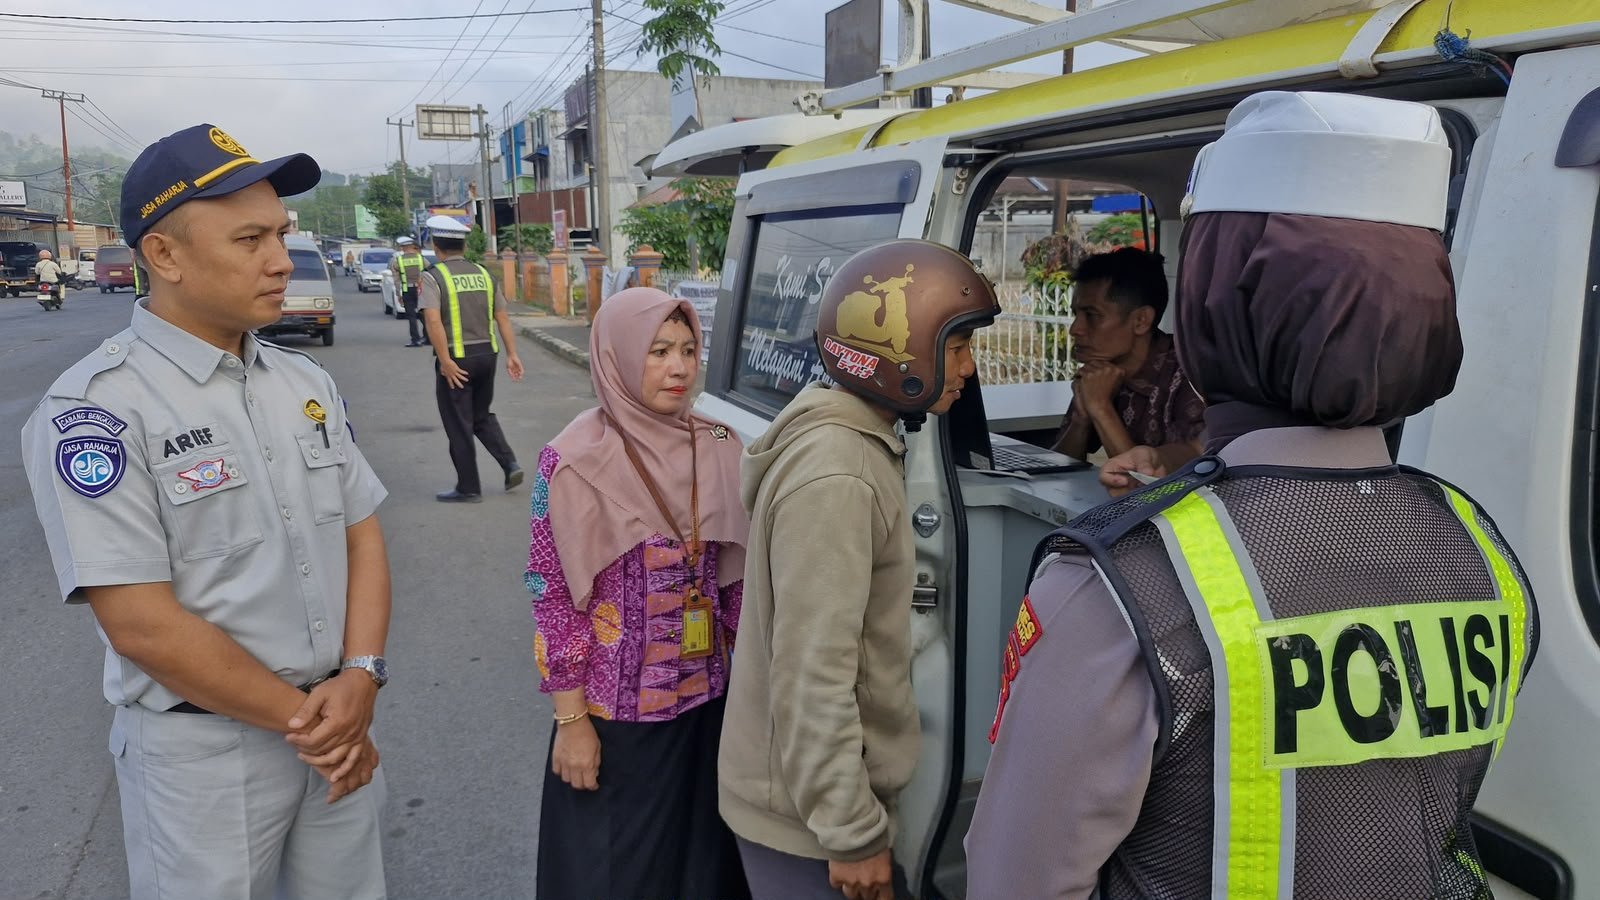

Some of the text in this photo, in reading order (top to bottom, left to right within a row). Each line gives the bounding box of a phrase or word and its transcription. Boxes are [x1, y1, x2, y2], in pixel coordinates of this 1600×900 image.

[140, 180, 188, 219] JASA RAHARJA
[772, 254, 811, 300] Kami
[748, 327, 807, 390] Melayani
[824, 337, 879, 370] DAYTONA
[60, 411, 120, 431] CABANG BENGKULU
[63, 442, 118, 455] JASA RAHARJA
[163, 427, 213, 459] ARIEF
[1266, 614, 1510, 755] POLISI
